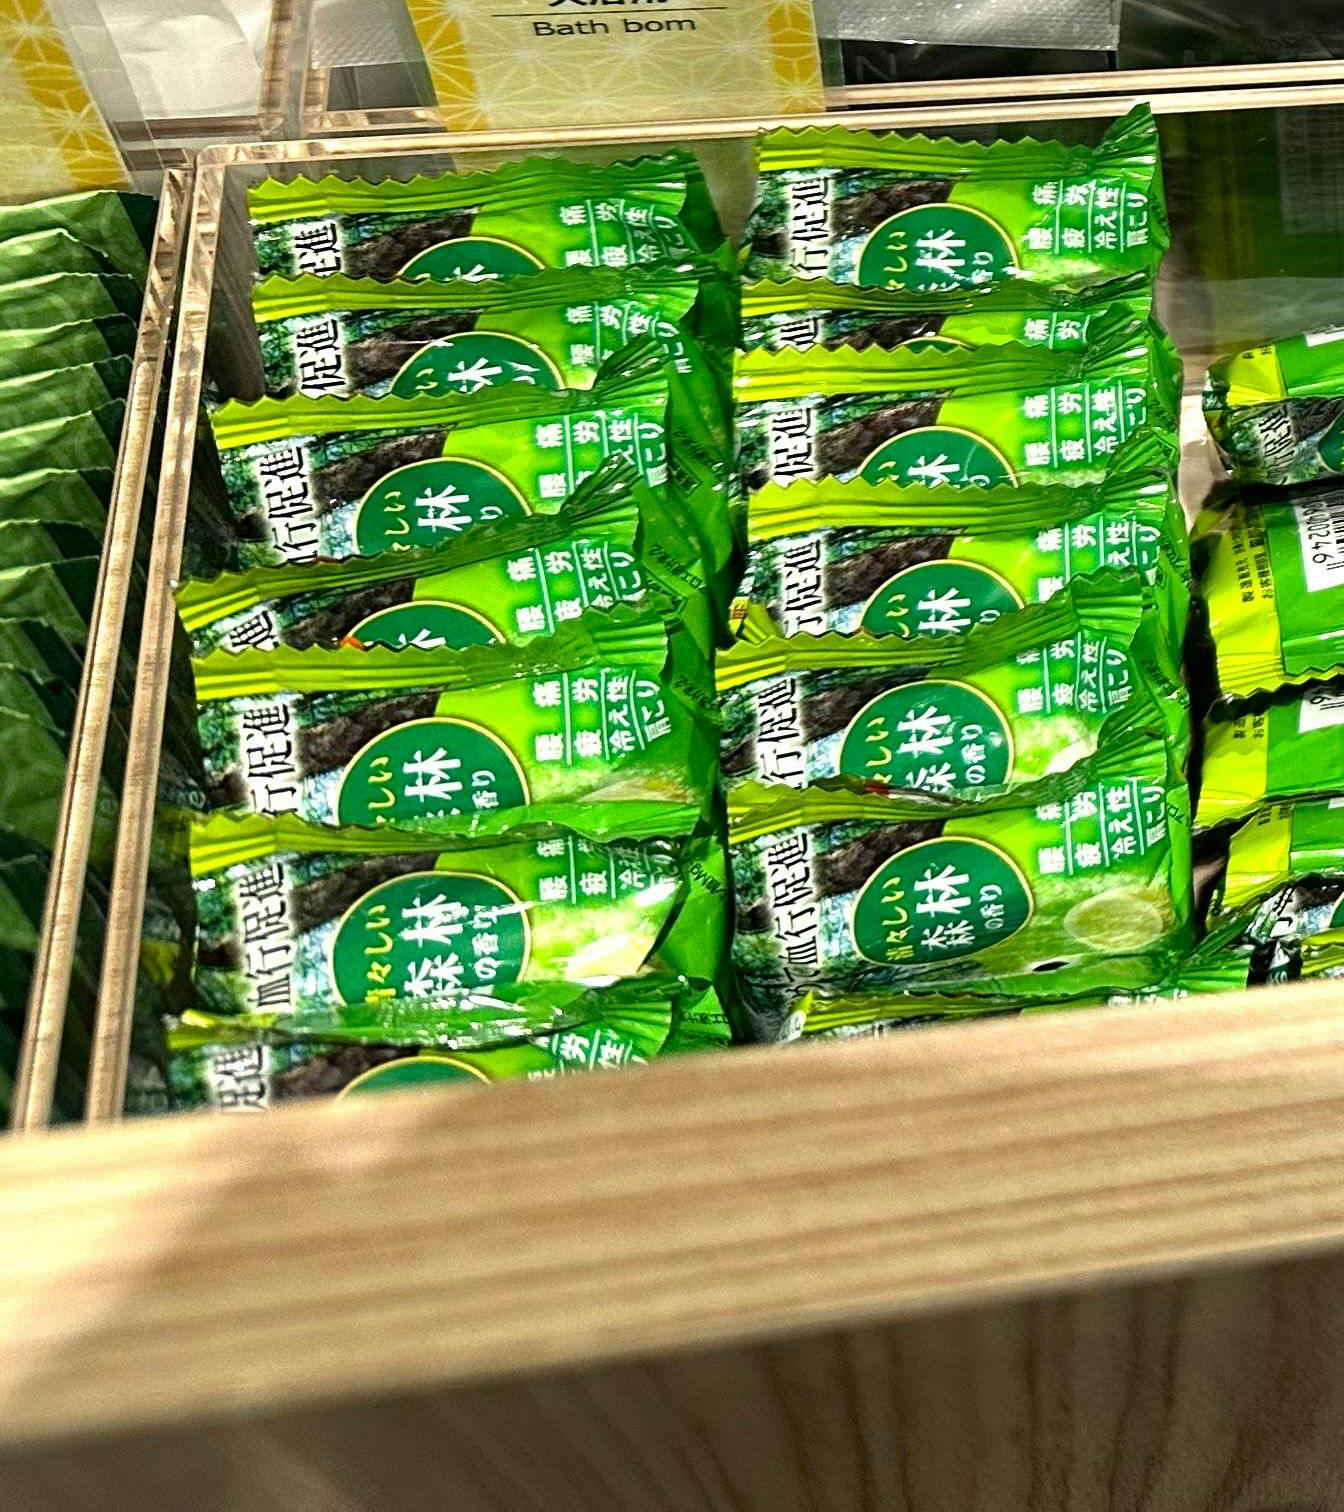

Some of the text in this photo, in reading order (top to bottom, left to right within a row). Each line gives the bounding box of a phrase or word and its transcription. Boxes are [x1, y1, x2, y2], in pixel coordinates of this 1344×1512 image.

[532, 15, 697, 38] Bath bom
[790, 178, 829, 273] 行促進
[1027, 182, 1058, 249] 腰痛
[1063, 183, 1090, 249] 疲労
[1094, 187, 1120, 249] 冷え性
[1125, 193, 1149, 246] 肩こり
[296, 319, 346, 392] 促進
[566, 305, 595, 367] 腰痛
[771, 408, 814, 477] 促進
[1023, 394, 1051, 466] 腰痛
[1058, 393, 1085, 461] 疲労
[1092, 388, 1120, 456] 冷え性
[536, 423, 567, 499] 腰痛
[508, 556, 546, 632] 腰痛
[1049, 638, 1077, 705] 疲労
[1079, 640, 1101, 713] 冷え性
[1104, 648, 1133, 703] 肩こり
[534, 680, 564, 762] 腰痛
[572, 677, 602, 757] 疲労
[604, 676, 635, 756] 冷え性
[638, 678, 673, 742] 肩こり
[895, 706, 957, 794] 森林
[959, 723, 987, 784] の香り
[1071, 791, 1103, 868] 疲労
[1106, 785, 1137, 857] 冷え性
[1140, 785, 1168, 847] 肩こり
[239, 863, 294, 1009] 血行促進
[914, 865, 976, 950] 森林
[978, 883, 1005, 929] の香り
[400, 894, 468, 1000] 森林
